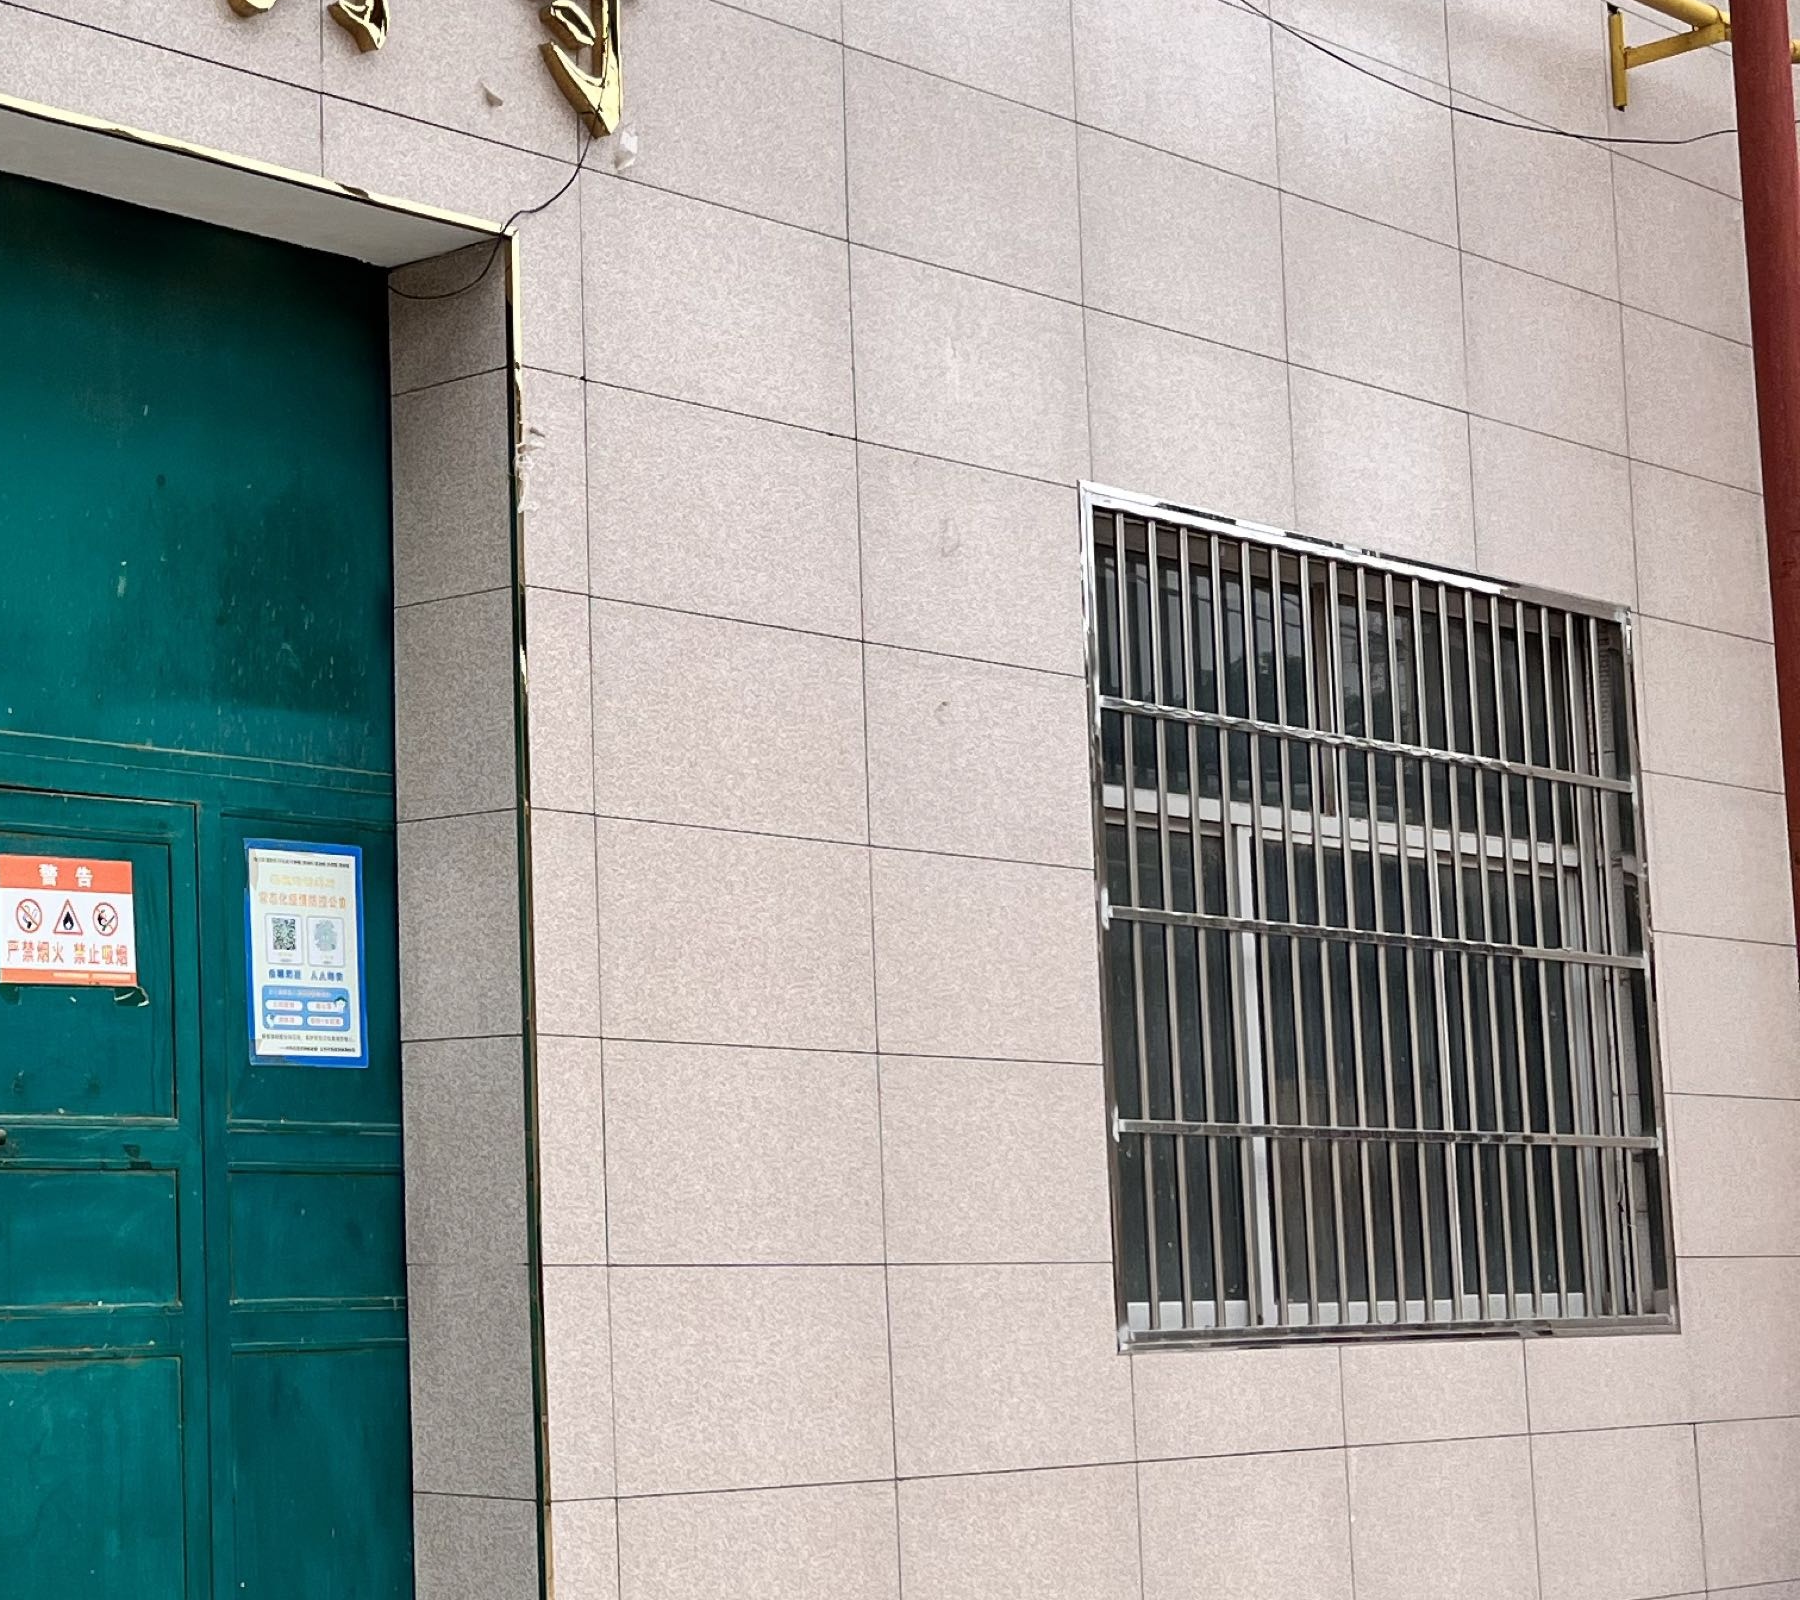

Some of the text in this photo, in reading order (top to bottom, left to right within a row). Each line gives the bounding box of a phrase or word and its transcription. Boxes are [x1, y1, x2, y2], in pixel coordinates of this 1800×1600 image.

[38, 863, 93, 888] 警告
[7, 940, 128, 967] 严禁烟火 禁止吸烟
